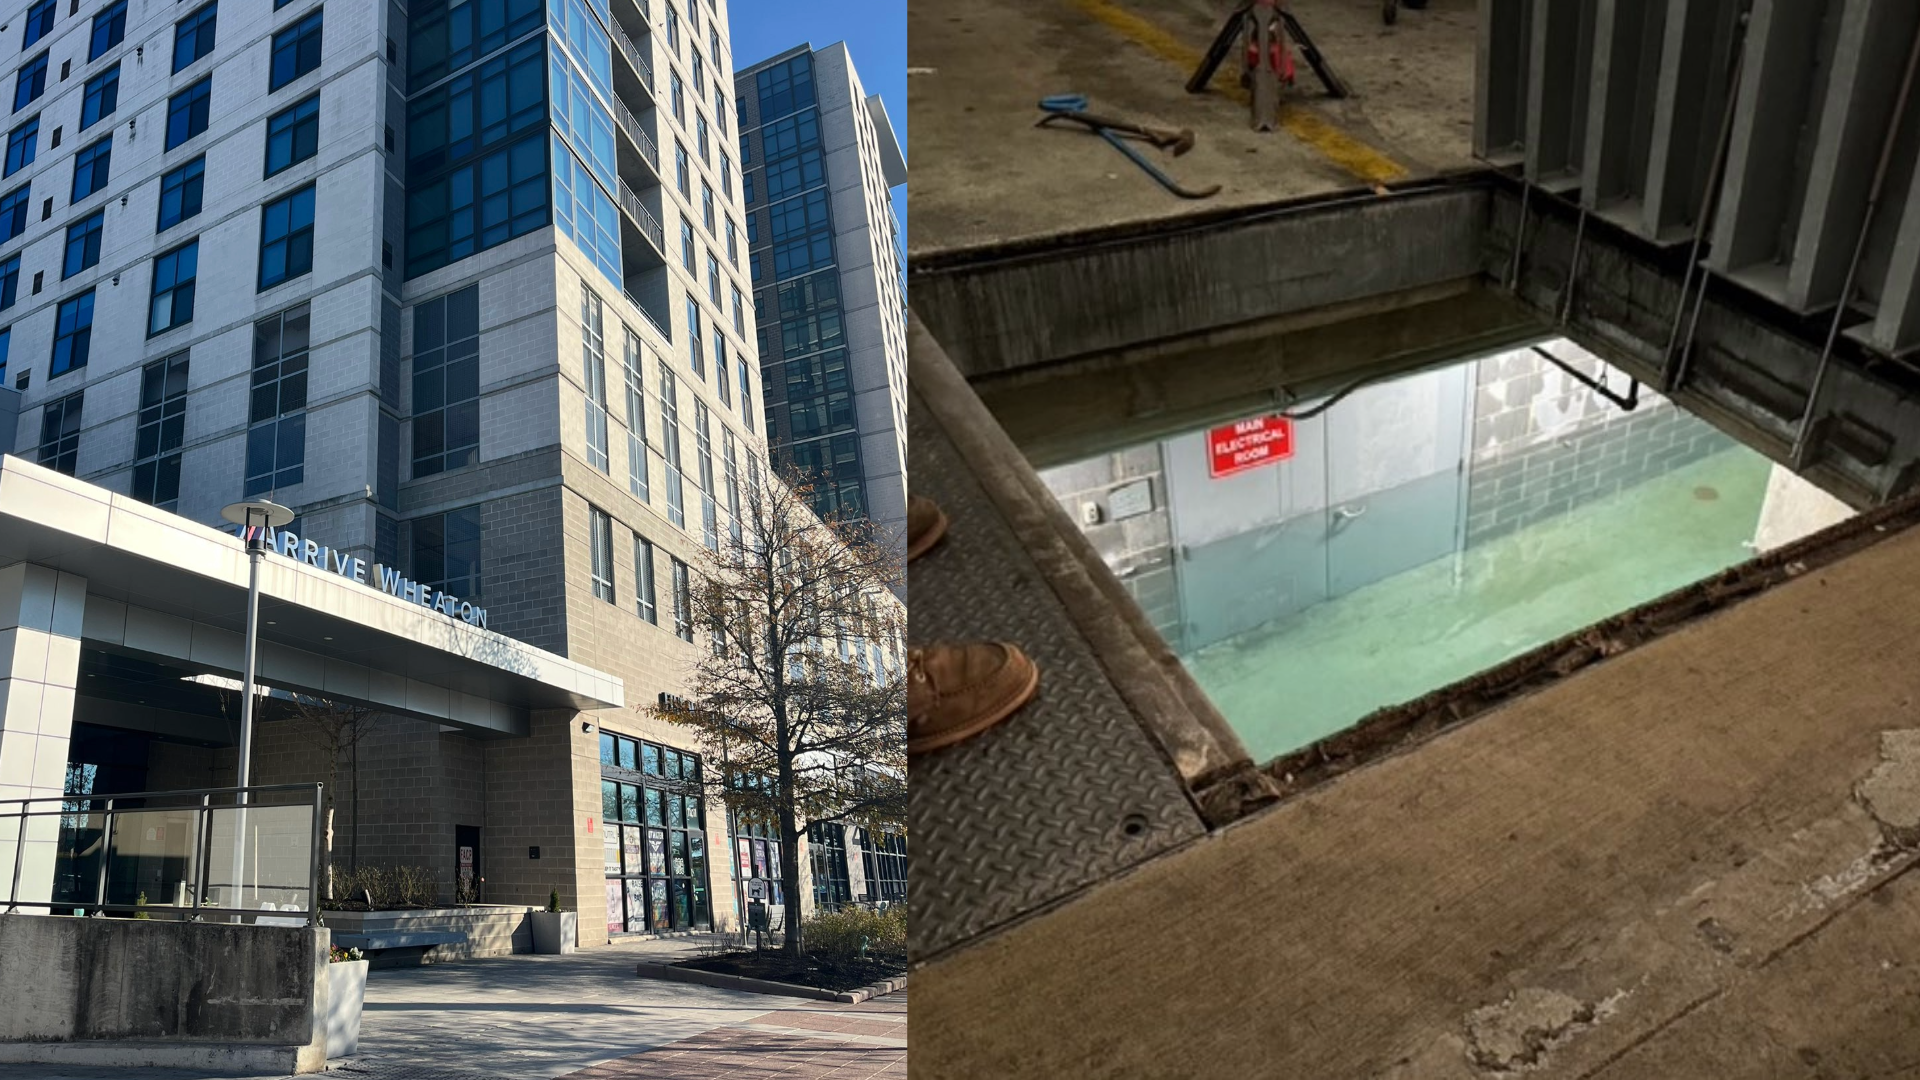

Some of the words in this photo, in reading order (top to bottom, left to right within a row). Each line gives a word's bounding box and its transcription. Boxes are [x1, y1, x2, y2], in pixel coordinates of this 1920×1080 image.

[1235, 418, 1264, 434] MAIN
[1215, 428, 1285, 455] ELECTRICAL
[1234, 445, 1269, 464] ROOM
[259, 526, 366, 583] ARRIVE
[376, 563, 487, 630] WHEATON
